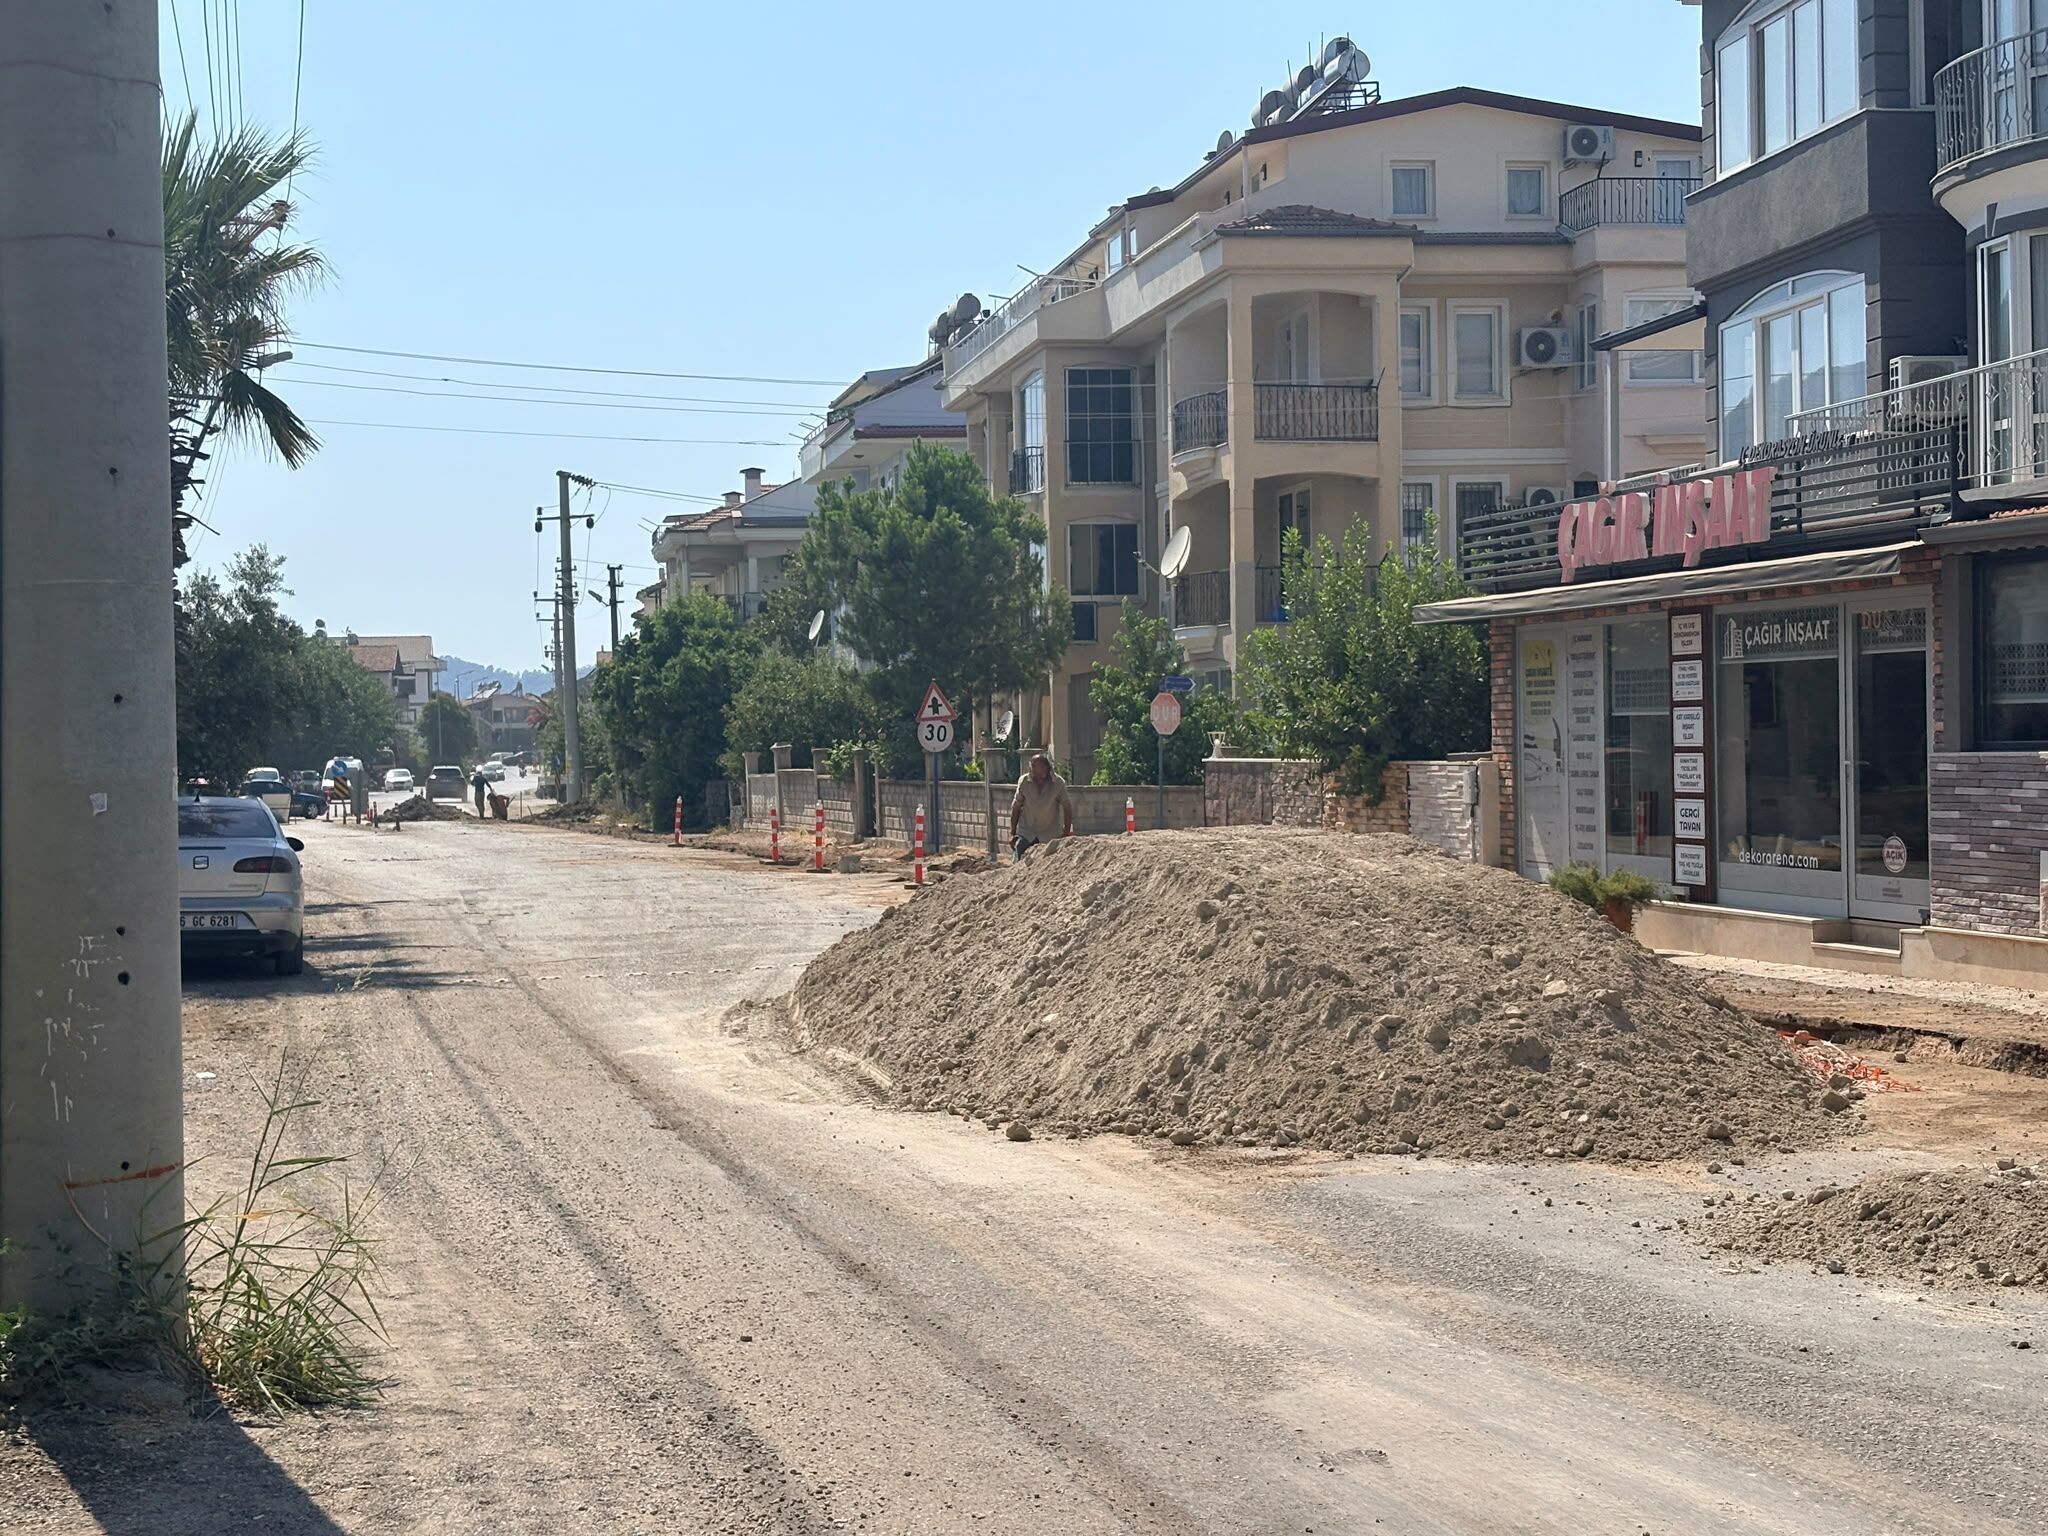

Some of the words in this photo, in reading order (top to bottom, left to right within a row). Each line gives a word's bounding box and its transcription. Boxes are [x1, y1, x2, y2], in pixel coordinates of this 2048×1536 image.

[1558, 480, 1650, 583] ÇAĞIR
[1652, 467, 1777, 568] İNŞAAT
[1744, 621, 1781, 649] ÇAĞIR
[1784, 618, 1830, 645] İNŞAAT
[1153, 705, 1178, 721] DUR
[925, 724, 947, 742] 30
[1680, 807, 1700, 818] GERGİ
[1679, 821, 1700, 832] TAVAN
[1739, 848, 1819, 869] dekorarena.com
[1886, 850, 1903, 861] AÇIK
[193, 916, 205, 927] GC
[210, 915, 235, 927] 6281
